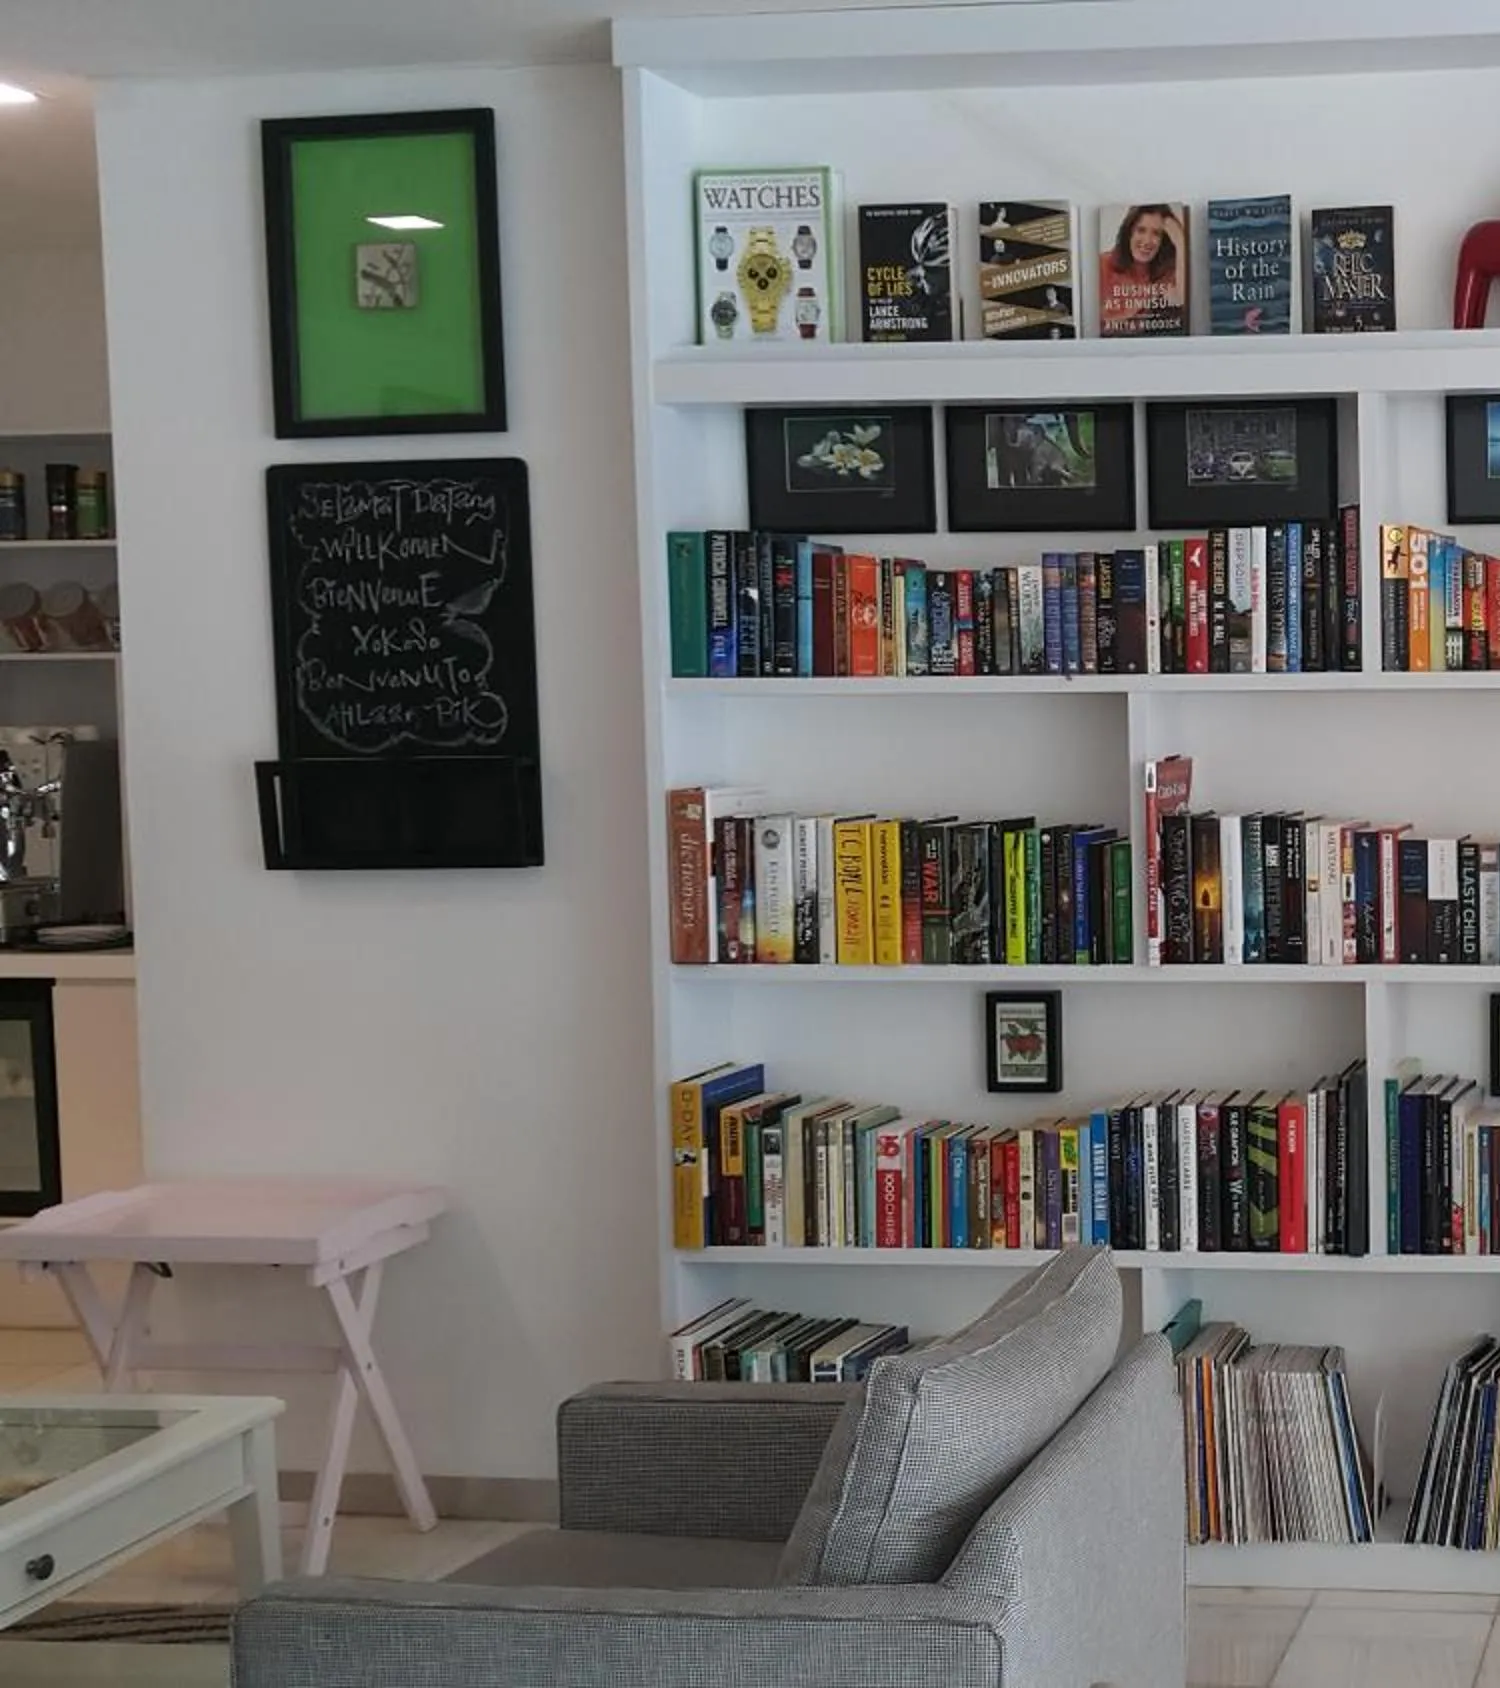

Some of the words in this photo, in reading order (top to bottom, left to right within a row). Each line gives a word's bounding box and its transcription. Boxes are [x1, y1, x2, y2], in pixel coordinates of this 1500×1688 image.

[703, 184, 821, 210] WATCHES
[1215, 235, 1288, 257] History
[867, 266, 905, 281] CYCLE
[991, 258, 1069, 289] INNOVATORS
[1224, 260, 1247, 281] of
[1251, 258, 1281, 279] the
[1333, 251, 1374, 277] RELIC
[867, 282, 885, 297] OF
[886, 281, 914, 297] LIES
[1231, 280, 1276, 302] Rain
[1322, 272, 1389, 301] MASTER
[868, 305, 901, 317] LANCE
[1104, 299, 1121, 310] AS
[869, 316, 930, 330] ARMSTRONG
[1104, 318, 1137, 331] ANITA
[1410, 533, 1428, 590] 501
[922, 860, 940, 904] WAR
[1462, 868, 1477, 906] LAST
[1462, 908, 1477, 954] CHILD
